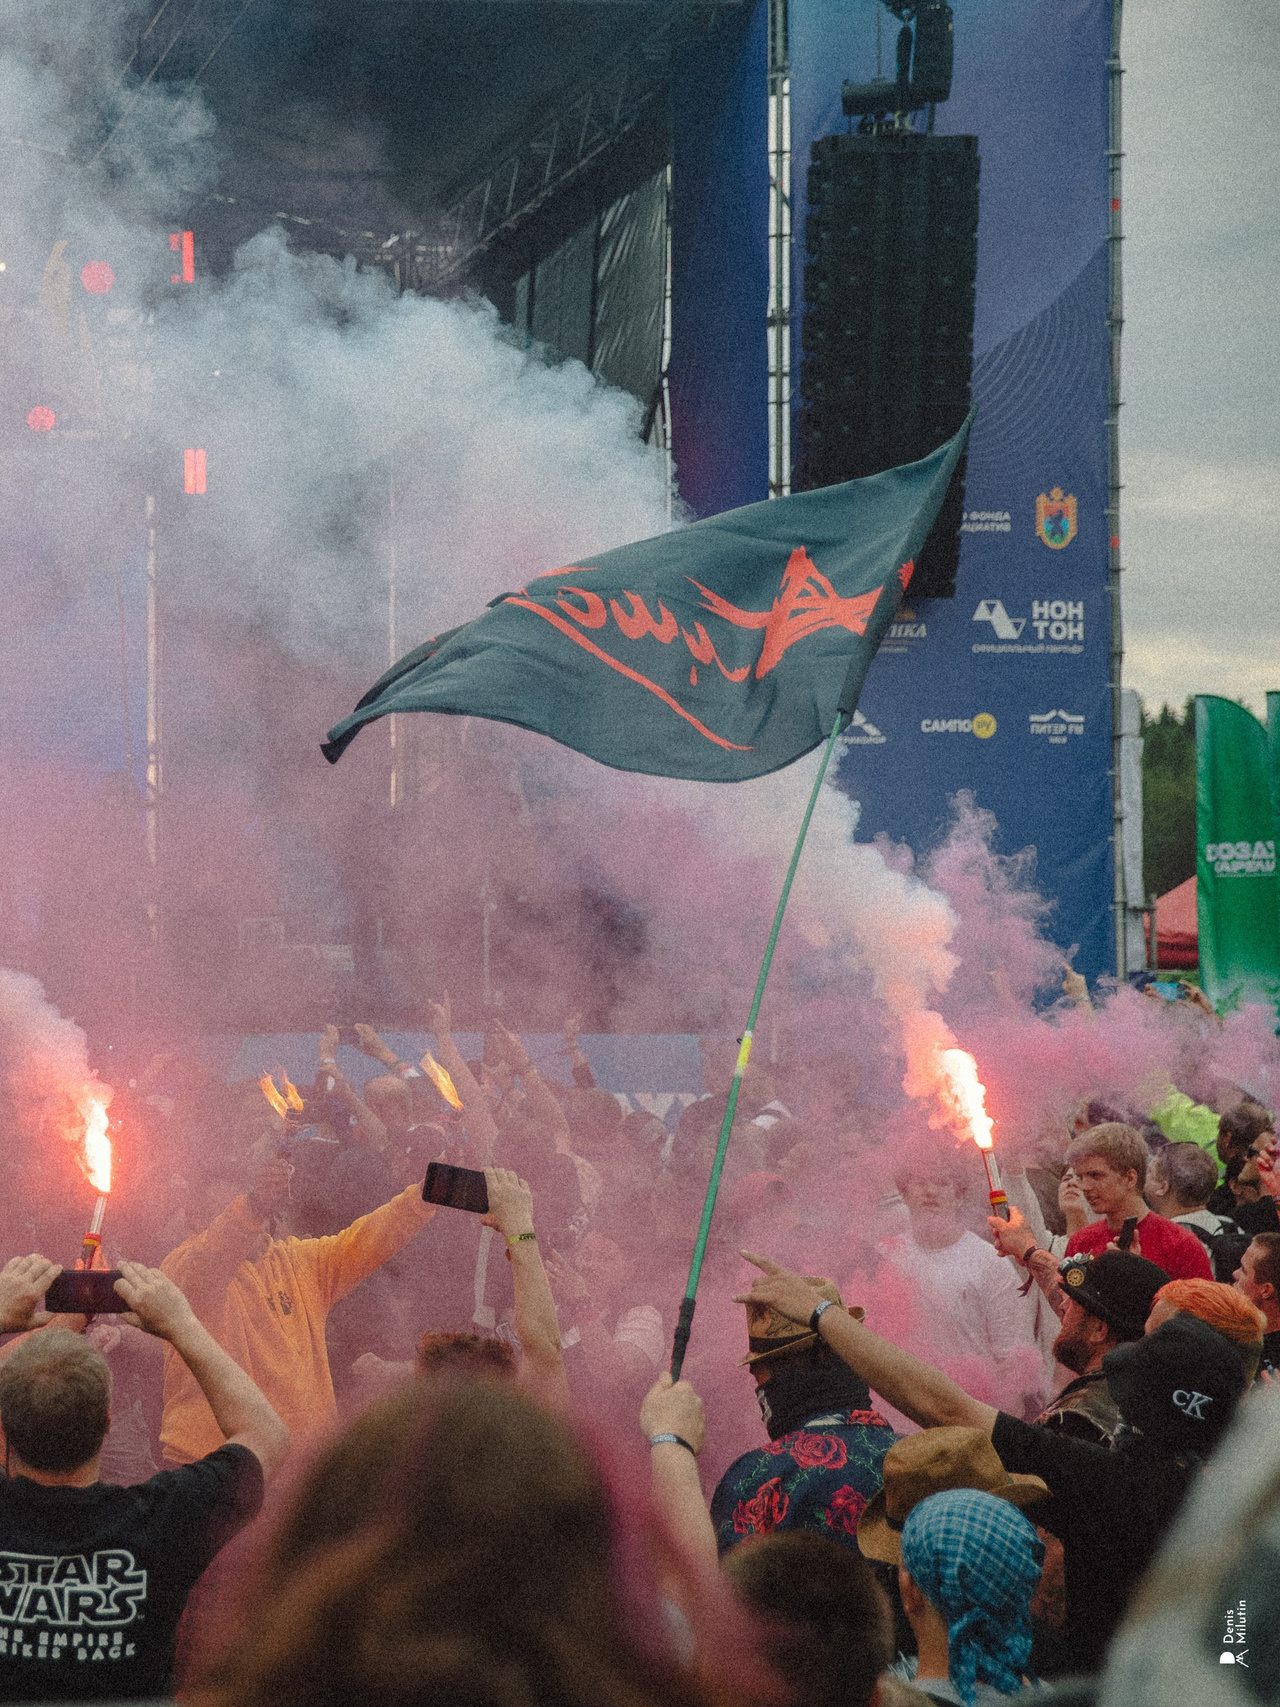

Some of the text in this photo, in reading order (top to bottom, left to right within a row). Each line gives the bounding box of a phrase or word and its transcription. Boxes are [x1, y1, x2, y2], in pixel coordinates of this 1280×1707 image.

[1032, 600, 1084, 620] НОН
[1032, 620, 1084, 640] ТОН
[39, 1631, 123, 1647] EMPIRE
[77, 1643, 136, 1661] BACK
